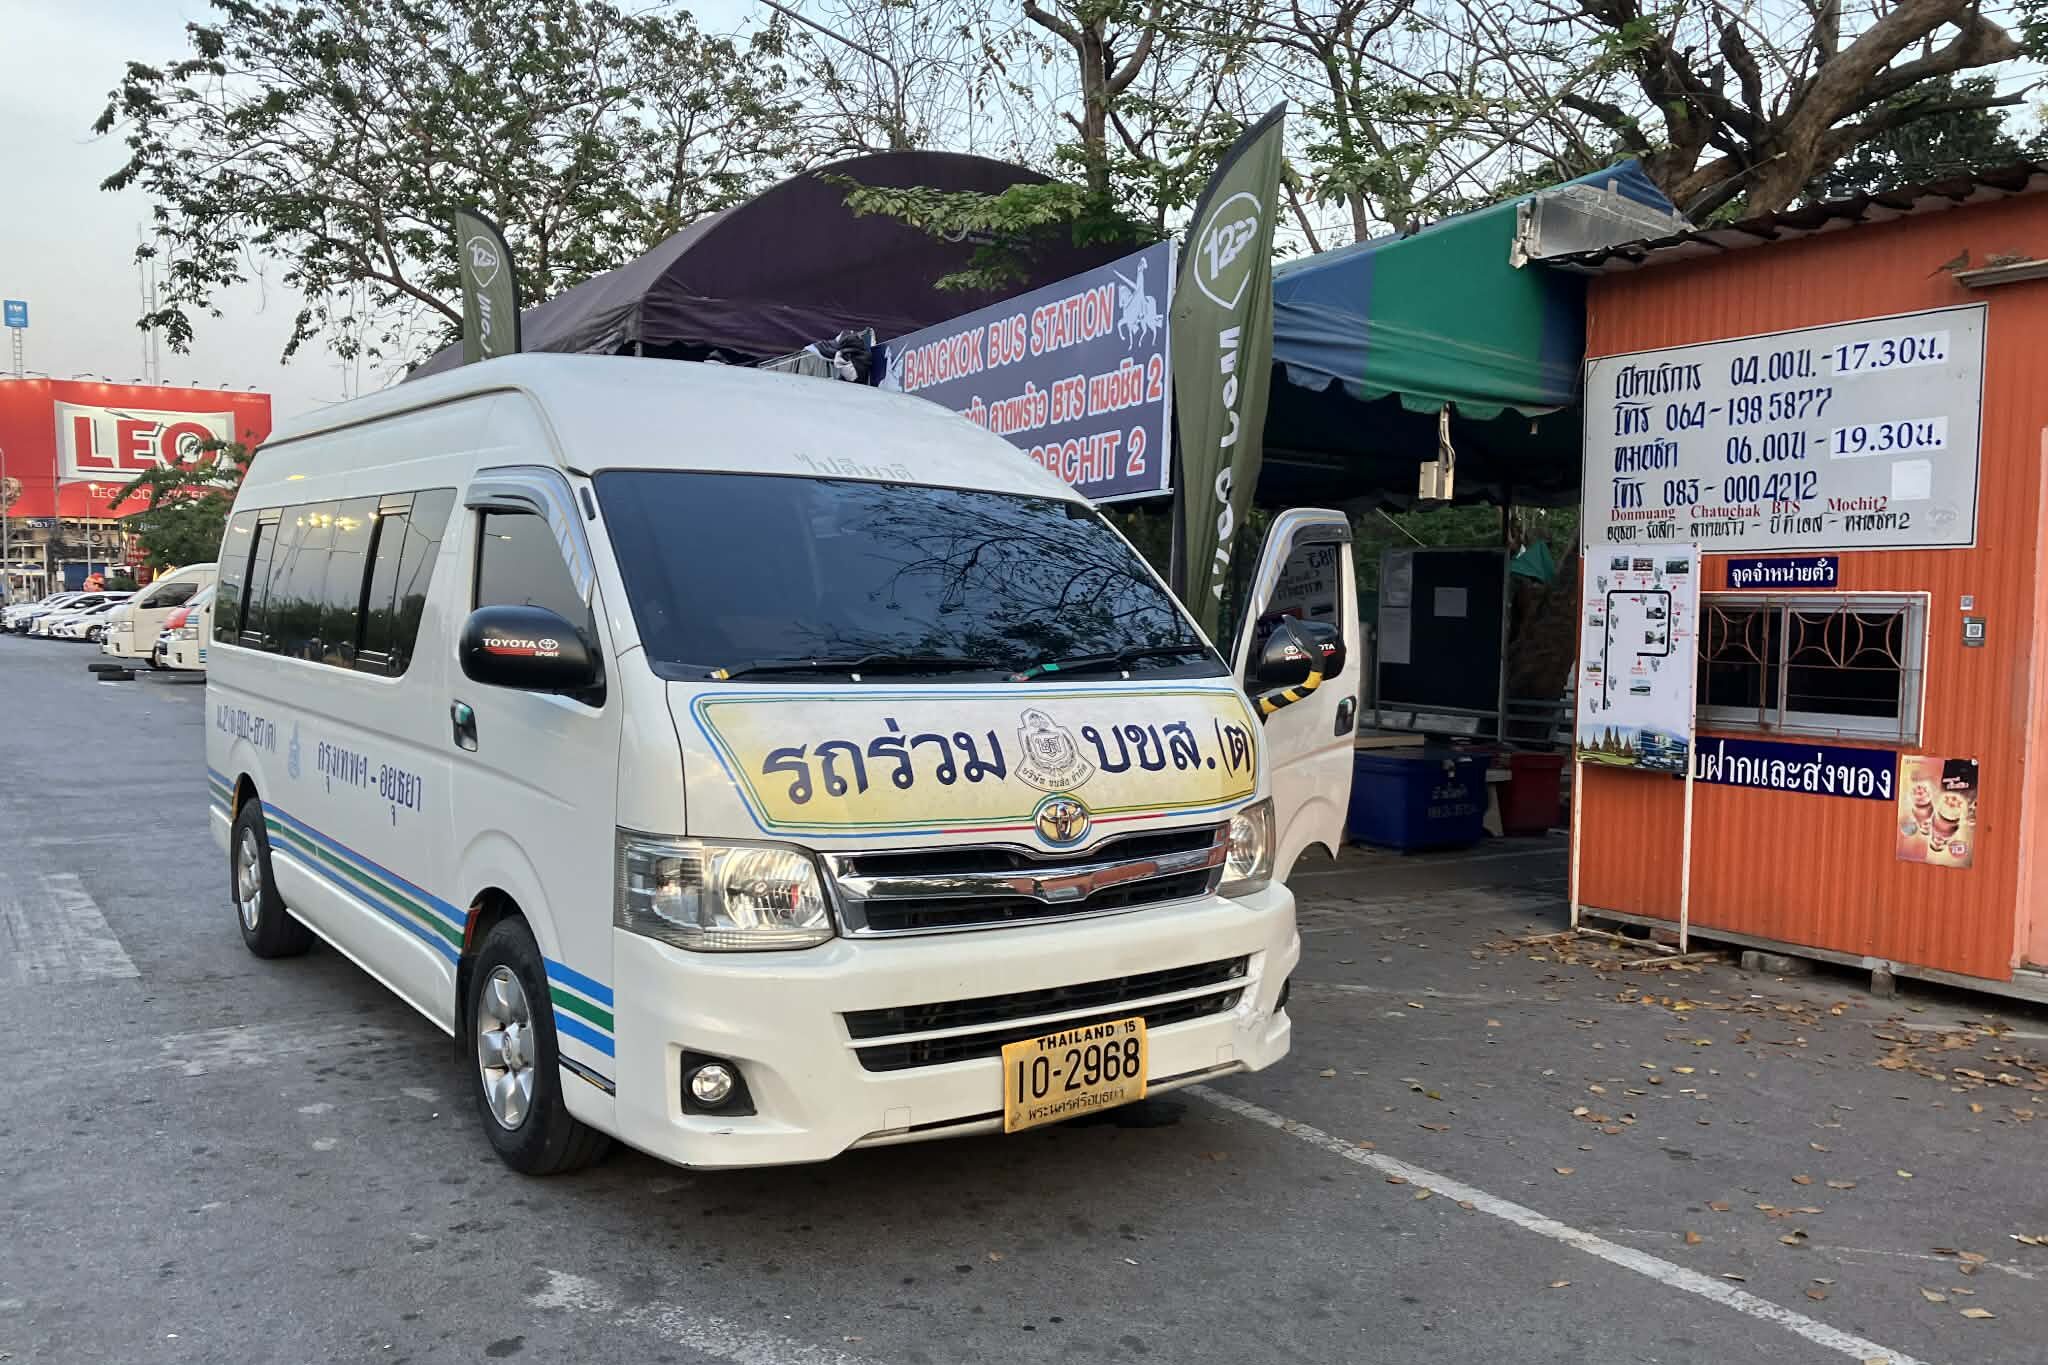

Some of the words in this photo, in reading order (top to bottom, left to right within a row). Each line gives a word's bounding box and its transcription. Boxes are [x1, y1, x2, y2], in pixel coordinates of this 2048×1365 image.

[904, 327, 984, 392] BANGKOK
[987, 313, 1026, 369] BUS
[1031, 282, 1115, 356] STATION
[990, 380, 1048, 435] ลาดพร้าว
[1050, 374, 1086, 424] BTS
[1088, 357, 1144, 416] หมอชิต
[1147, 353, 1163, 402] 2
[1615, 363, 1704, 400] เปิดบริการ
[1613, 402, 1655, 436] โทร
[74, 416, 217, 471] LEO
[1127, 426, 1146, 476] 2
[1615, 438, 1679, 473] หมอชิต
[1612, 476, 1647, 509] โทร
[1611, 508, 1677, 521] Donmuang
[1691, 504, 1761, 519] Chatuchak
[1772, 501, 1800, 514] BTS
[1732, 558, 1834, 588] จุดจำหน่ายตั๋ว
[482, 638, 537, 649] TOYOTA
[762, 719, 1007, 805] รถร่วม
[1037, 1025, 1115, 1051] THAILAND
[1124, 1020, 1136, 1034] 15
[1018, 1037, 1140, 1104] 10-2968
